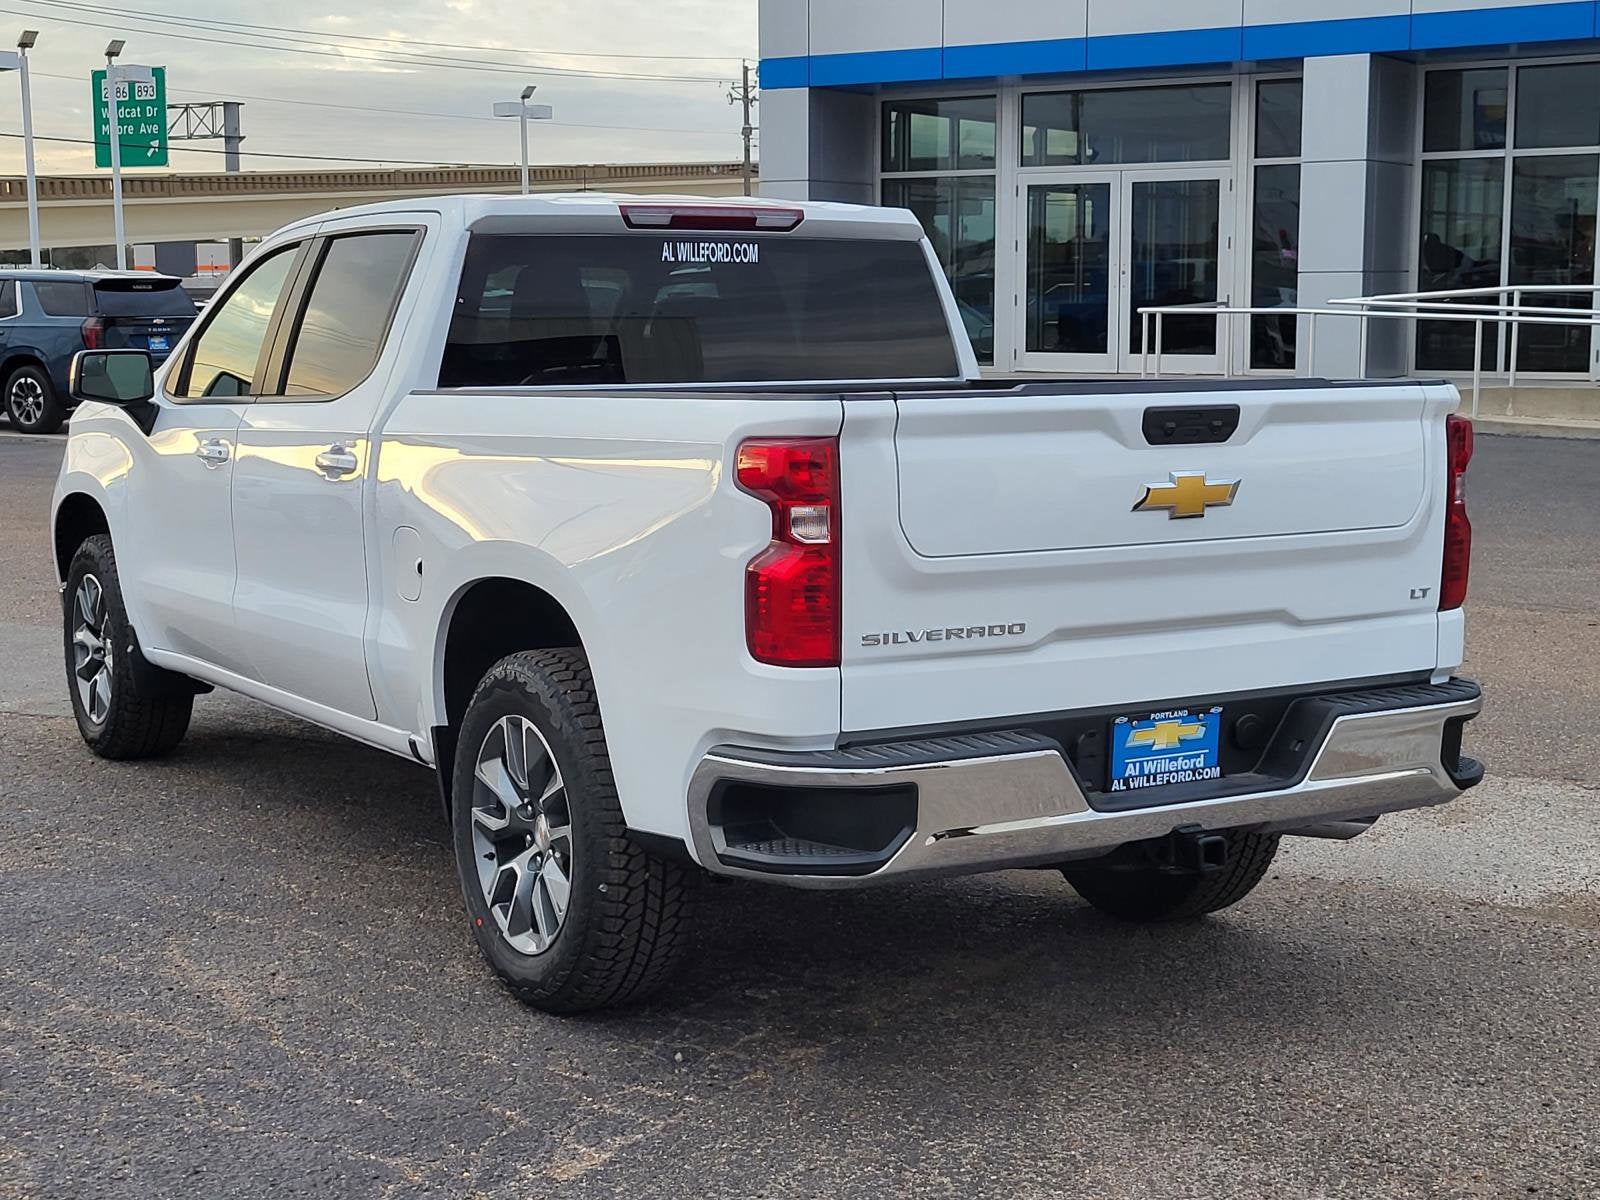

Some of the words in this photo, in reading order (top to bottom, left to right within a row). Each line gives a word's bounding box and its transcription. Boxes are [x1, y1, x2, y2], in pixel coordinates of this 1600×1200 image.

[103, 86, 128, 99] 286
[136, 85, 155, 98] 893
[101, 105, 141, 118] Wdcat
[146, 106, 158, 117] Dr
[101, 124, 134, 135] More
[139, 123, 159, 134] Ave
[661, 242, 675, 262] AL
[677, 242, 759, 263] WILLEFORD.COM
[1410, 587, 1431, 600] LT
[861, 622, 1026, 647] SILVERADO
[1150, 709, 1189, 720] PORTLAND
[1124, 761, 1139, 777] Al
[1143, 754, 1204, 775] Willeford
[1111, 779, 1127, 791] AL
[1129, 766, 1221, 789] WILLEFORD.COM
